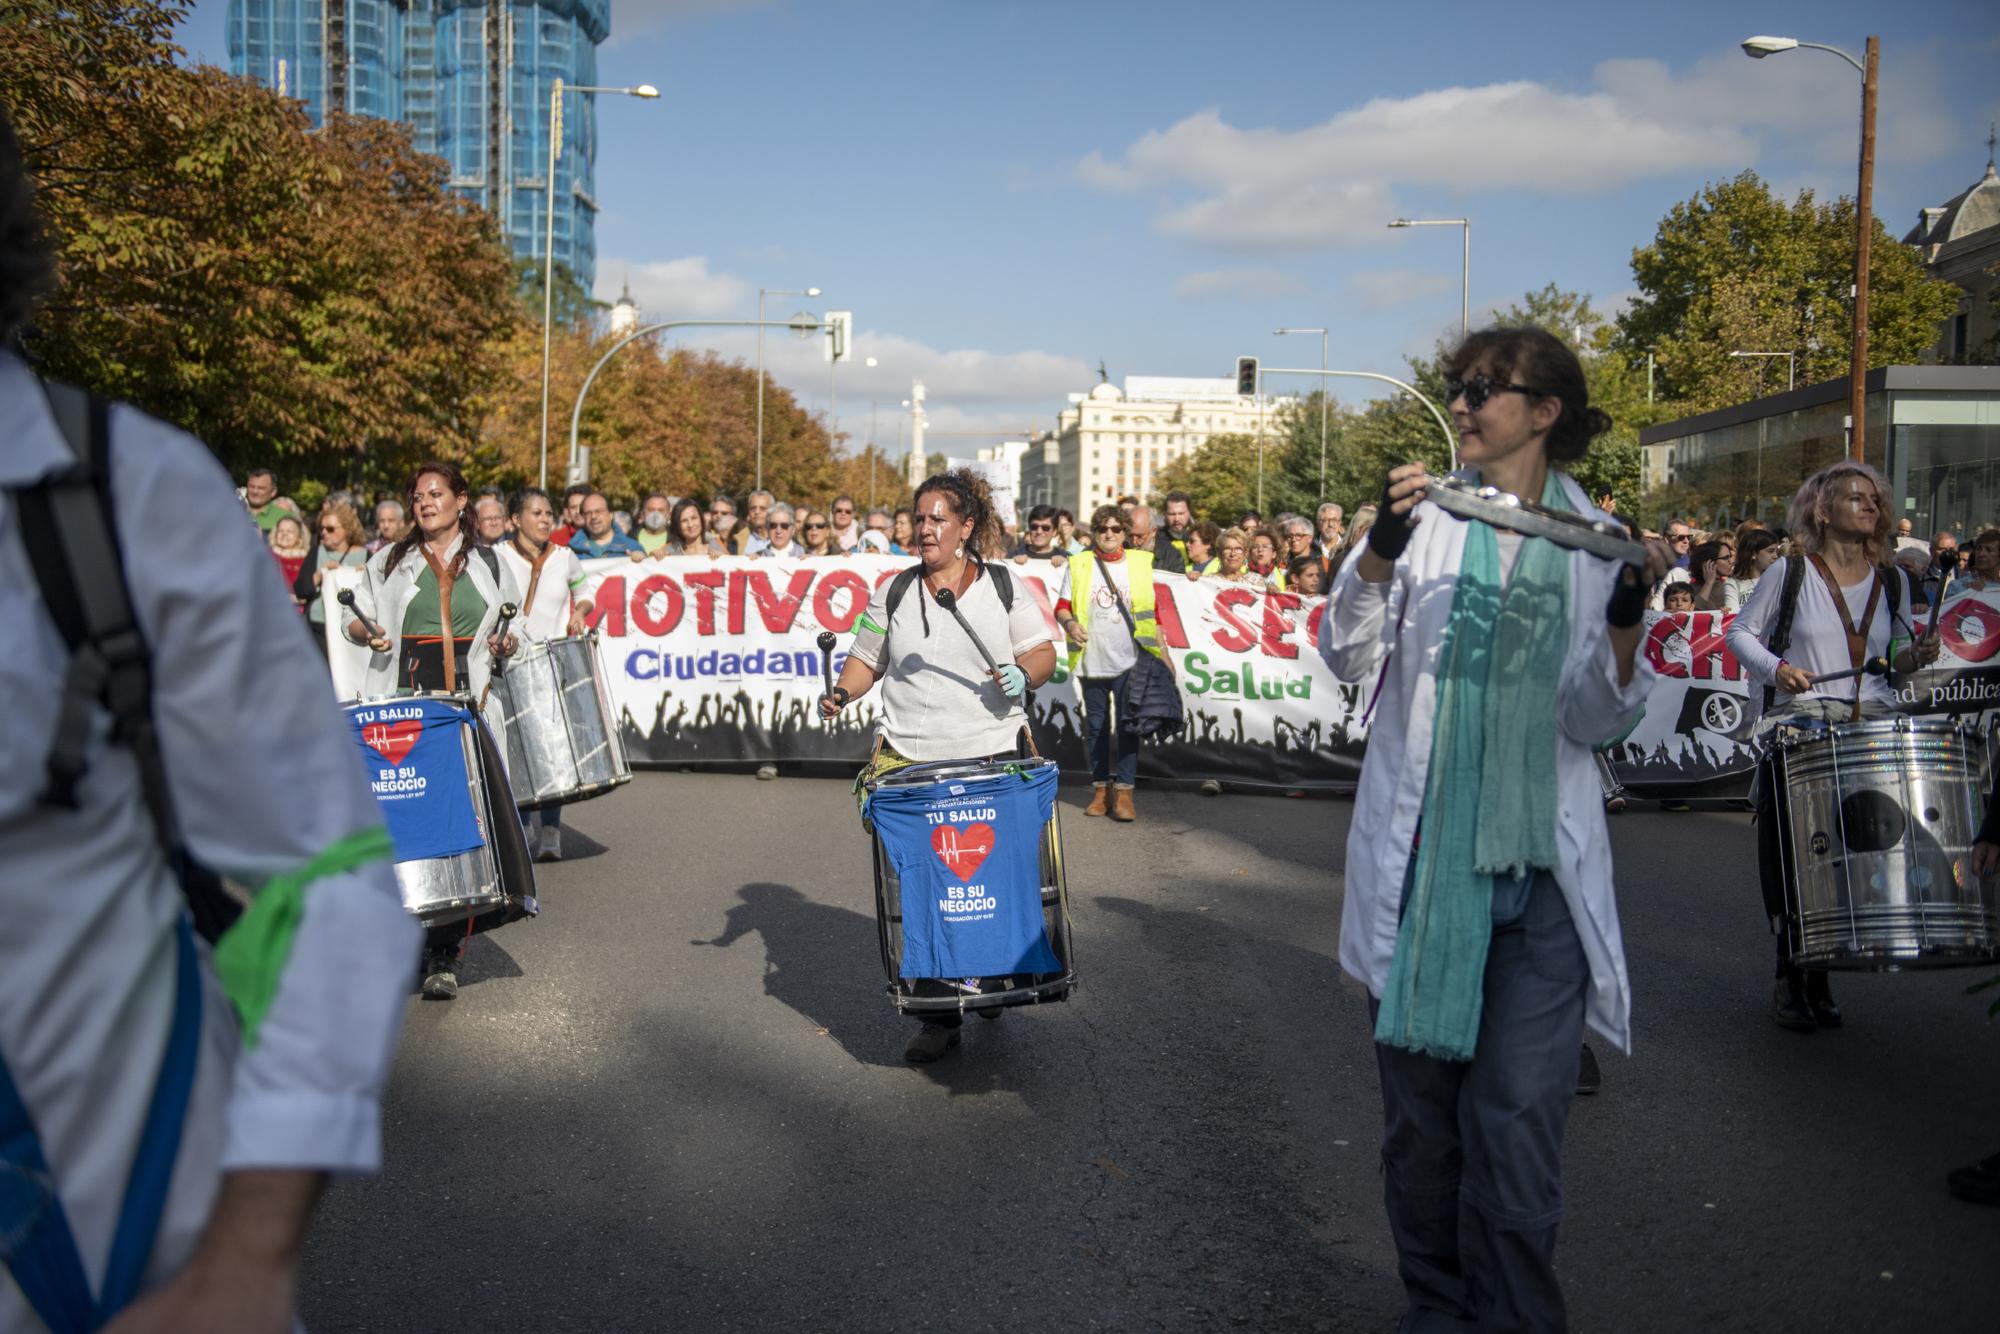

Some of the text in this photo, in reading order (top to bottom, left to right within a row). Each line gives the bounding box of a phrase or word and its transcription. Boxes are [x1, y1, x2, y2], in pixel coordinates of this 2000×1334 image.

[570, 568, 903, 638] MOTIVO
[626, 648, 1360, 714] Ciudadana Salud y
[1929, 678, 2000, 707] pública
[355, 708, 424, 724] TU SALUD
[380, 766, 416, 780] ES SU
[371, 777, 427, 792] NEGOCIO
[925, 808, 996, 825] TU SALUD
[947, 884, 985, 899] ES SU
[939, 896, 996, 913] NEGOCIO
